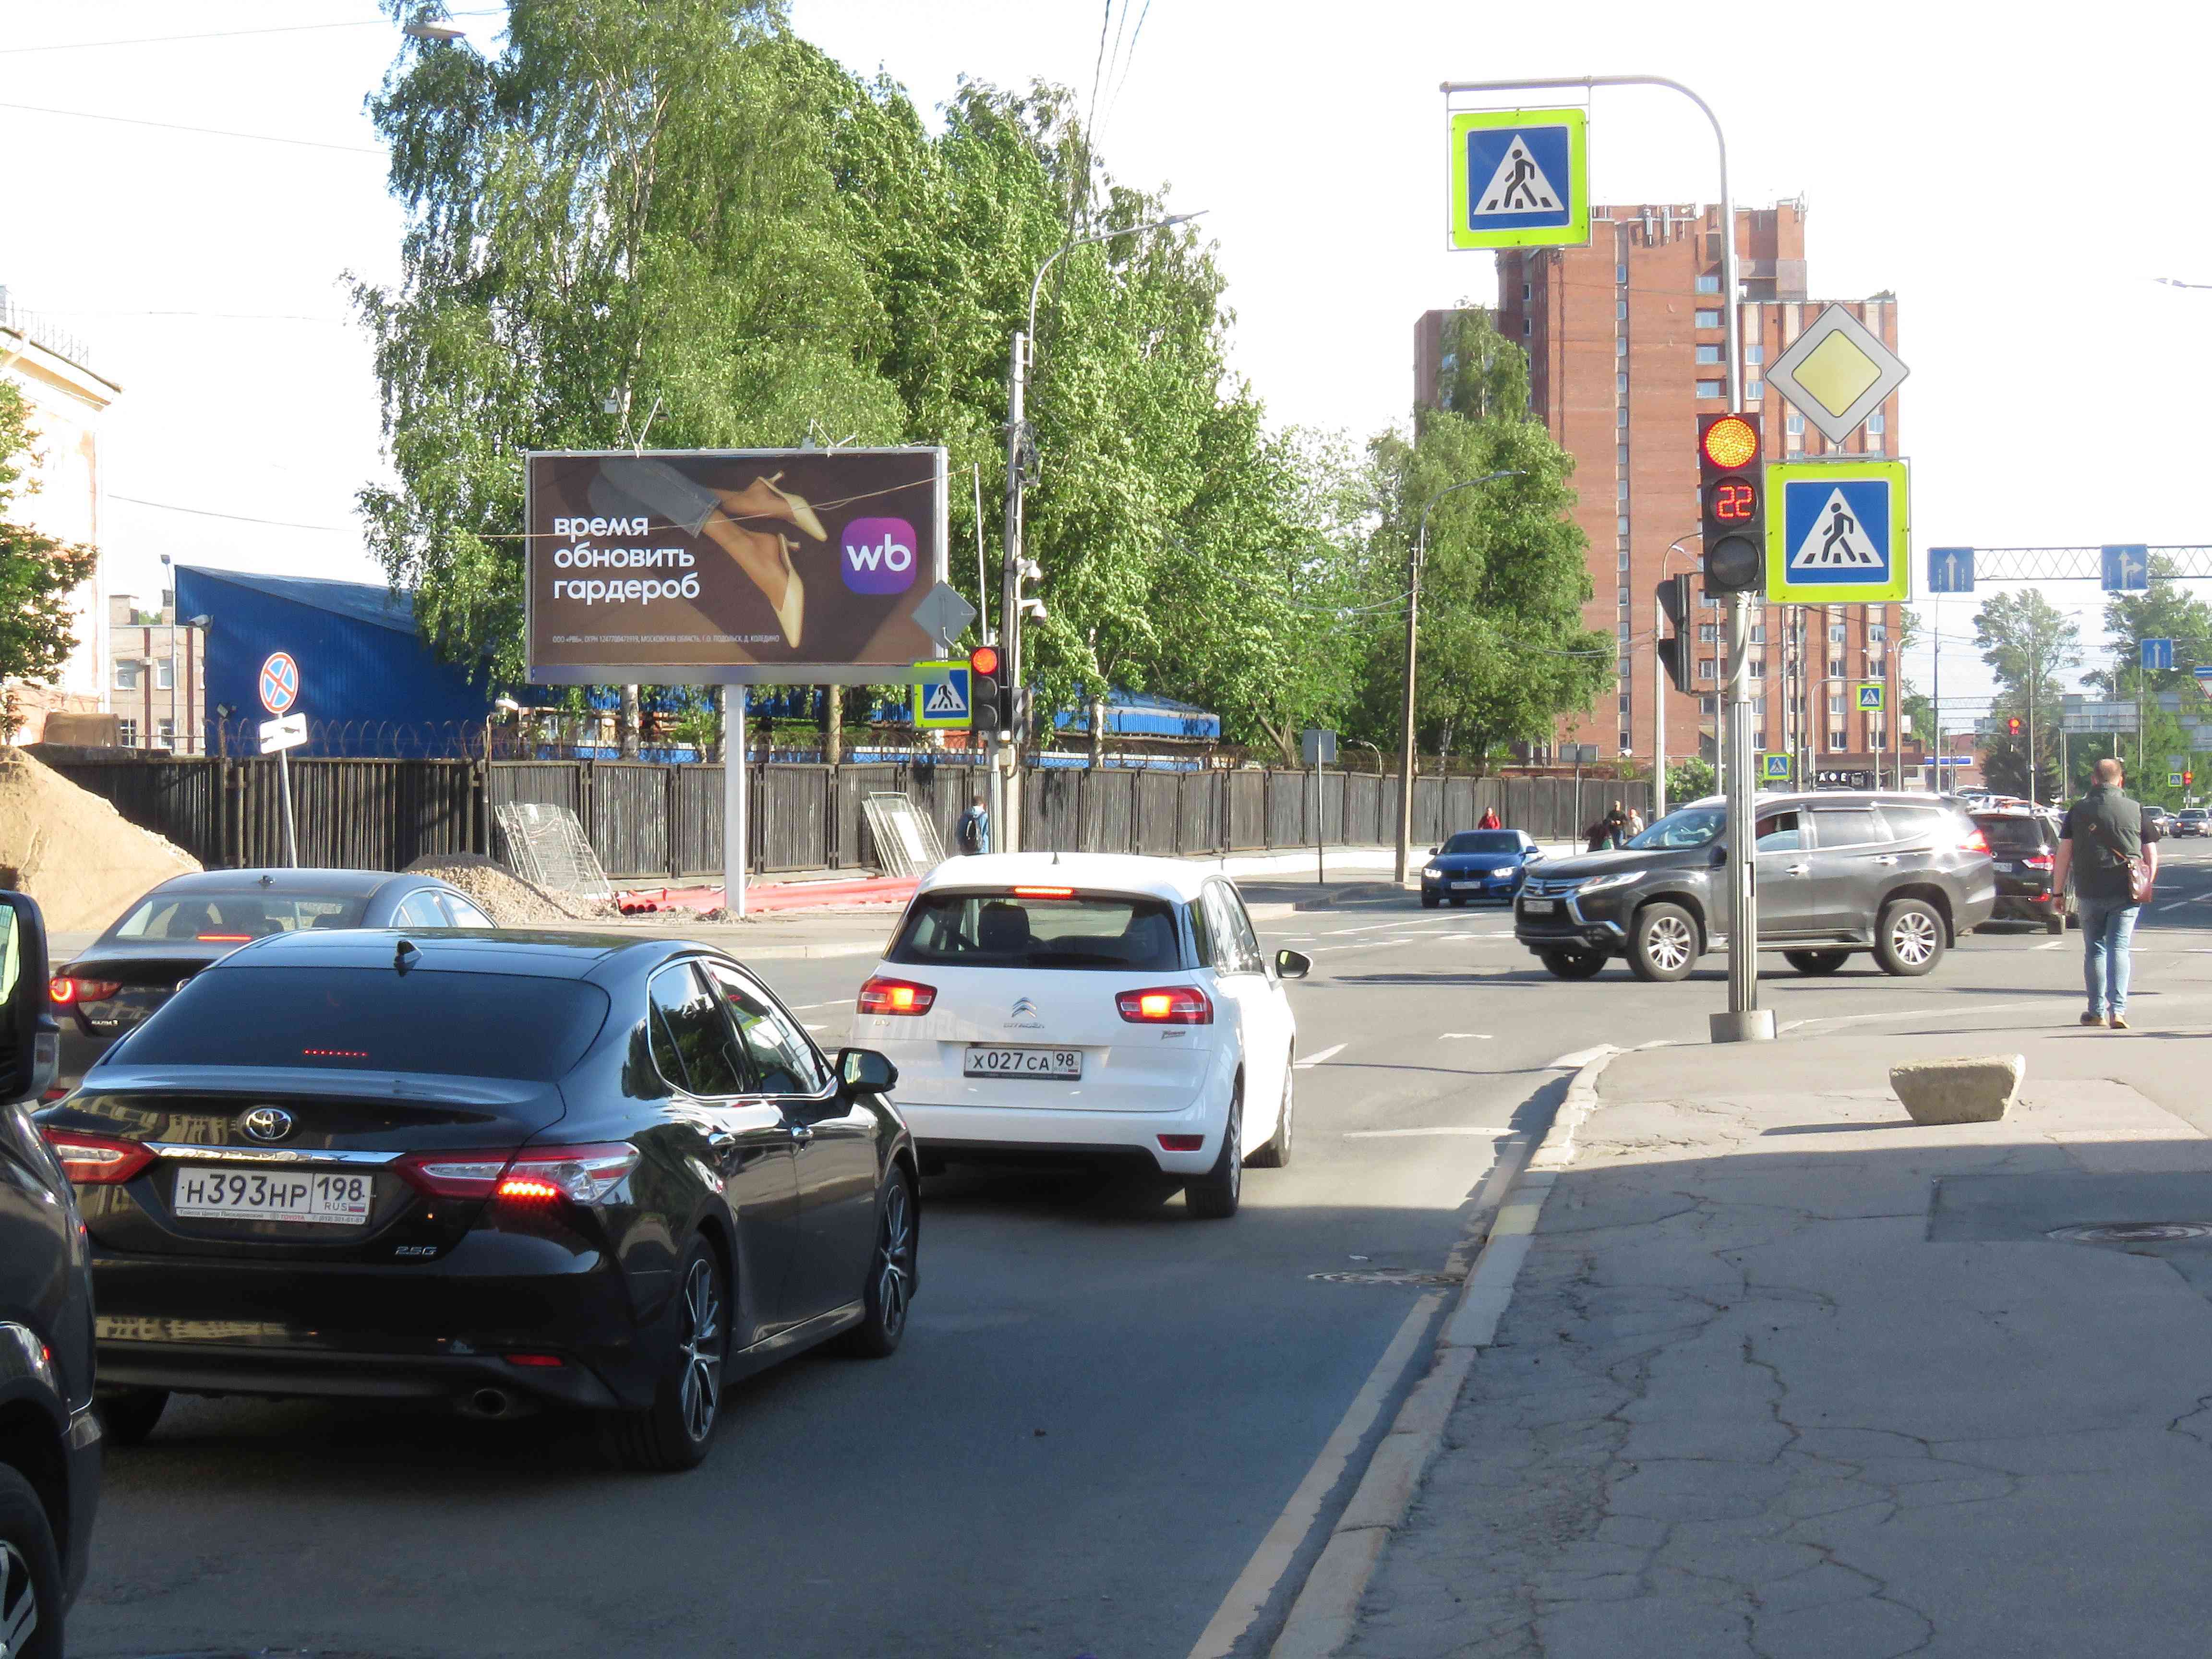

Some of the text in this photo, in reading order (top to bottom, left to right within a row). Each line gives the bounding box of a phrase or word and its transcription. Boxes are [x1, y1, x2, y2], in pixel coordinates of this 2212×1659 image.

[1717, 485, 1753, 517] 22
[554, 517, 648, 543] время
[554, 541, 695, 568] обновить
[846, 533, 912, 571] wb
[554, 572, 700, 605] гардероб
[1810, 772, 1847, 782] АФЕ
[1056, 1053, 1074, 1067] 98
[317, 1176, 363, 1202] 198
[324, 1202, 348, 1212] RUS
